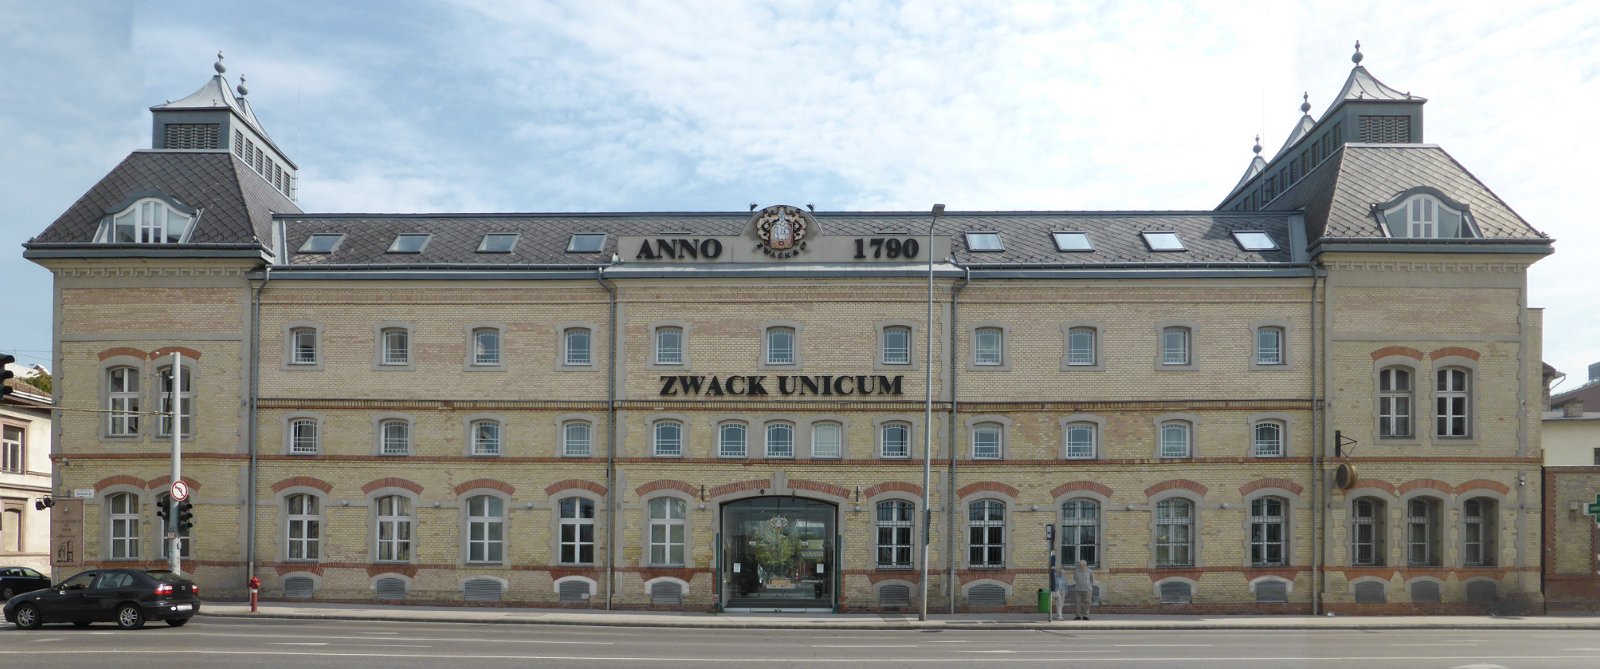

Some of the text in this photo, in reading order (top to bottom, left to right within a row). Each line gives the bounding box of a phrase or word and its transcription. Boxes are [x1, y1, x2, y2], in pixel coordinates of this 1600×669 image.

[636, 238, 723, 259] ANNO
[756, 242, 791, 259] ZWACK
[854, 238, 920, 259] 1790
[660, 375, 904, 396] ZWACK UNICUM
